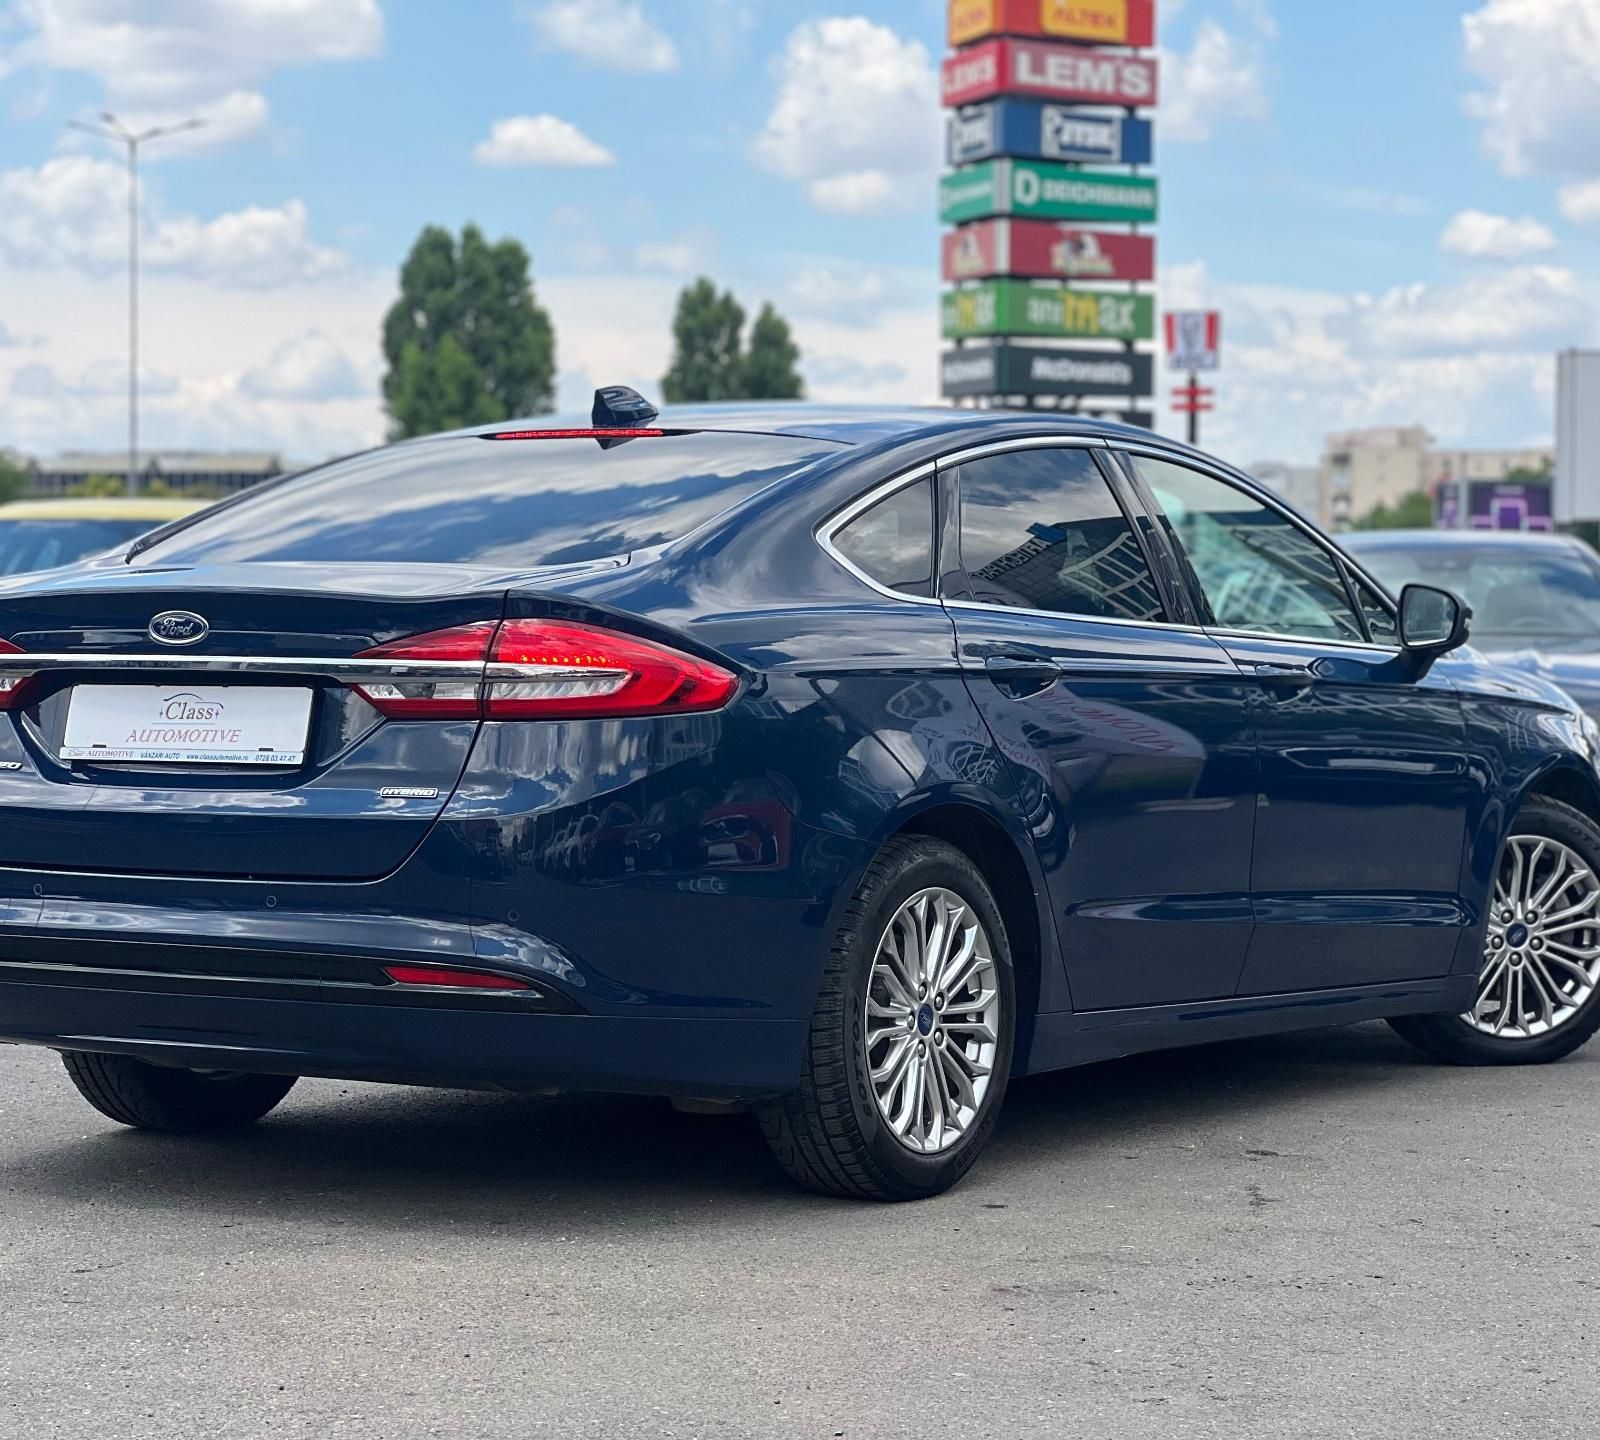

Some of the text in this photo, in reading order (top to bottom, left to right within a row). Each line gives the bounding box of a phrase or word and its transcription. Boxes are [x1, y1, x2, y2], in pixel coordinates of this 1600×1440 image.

[1014, 51, 1150, 98] LEM'S
[161, 617, 194, 636] Ford
[165, 701, 214, 720] Class
[125, 729, 242, 743] AUTOMOTIVE
[88, 750, 134, 758] AUTOMOTIVE
[164, 752, 180, 760] AUTO
[382, 788, 436, 796] HYBRID
